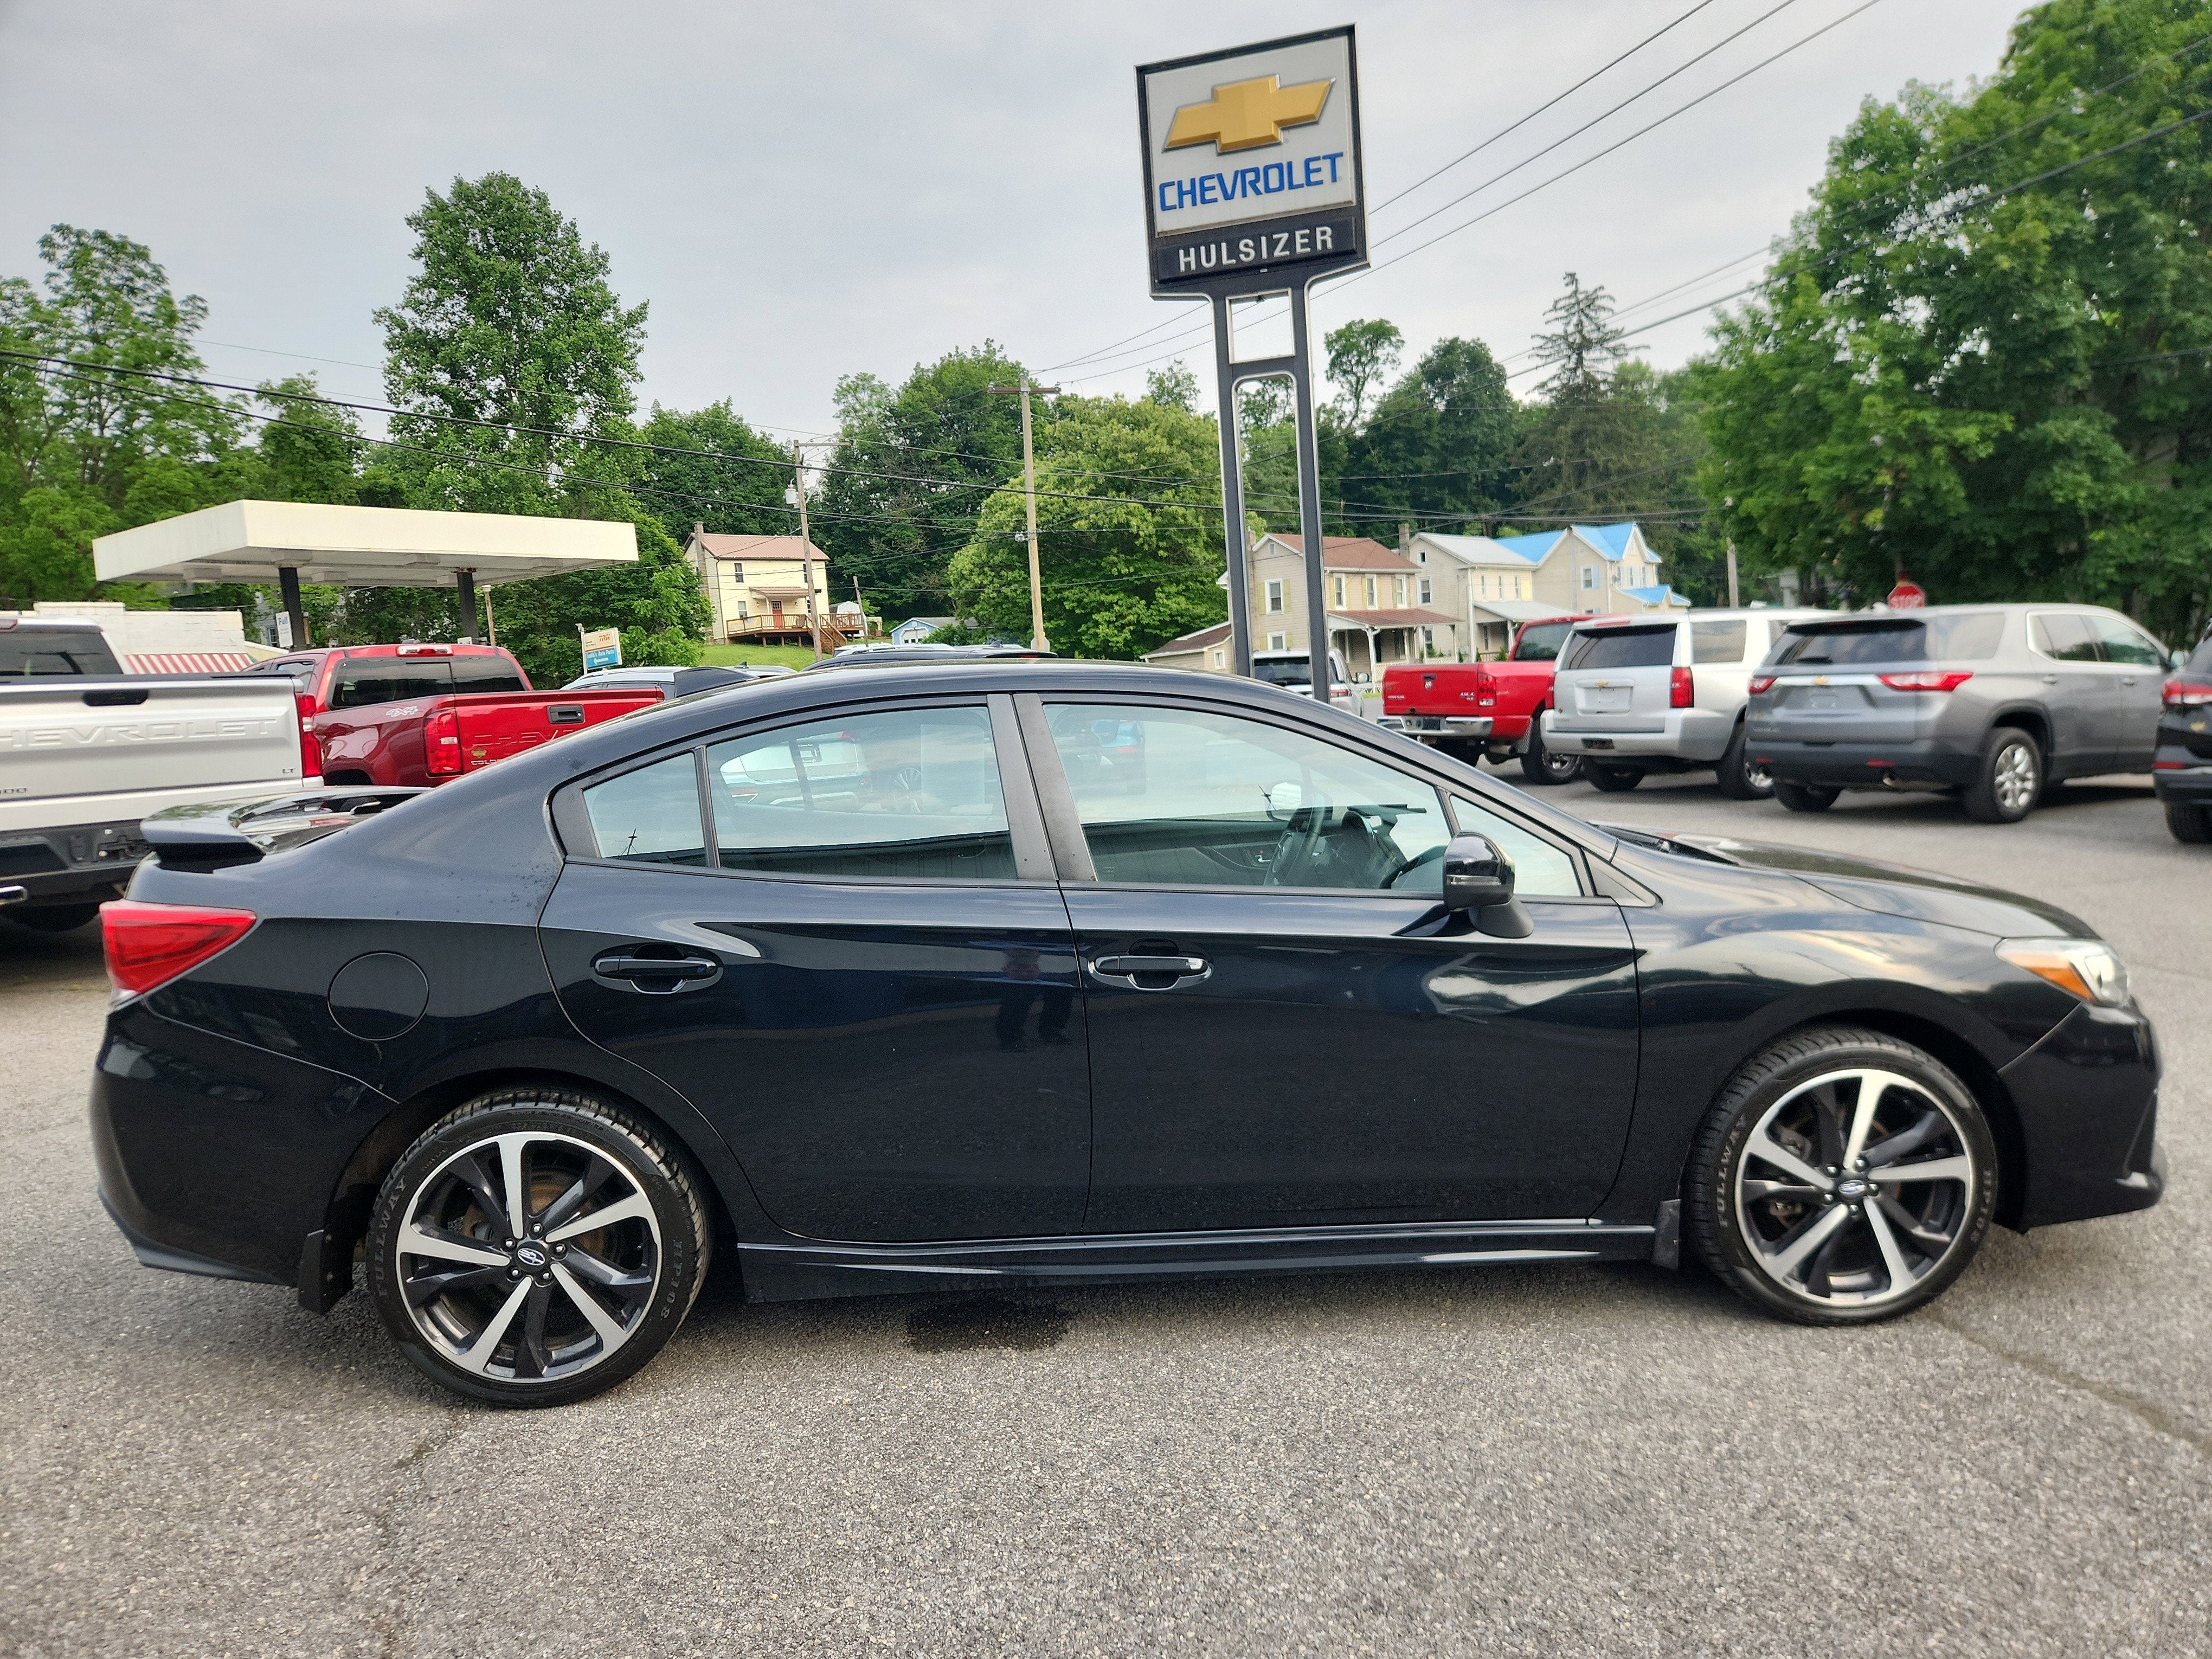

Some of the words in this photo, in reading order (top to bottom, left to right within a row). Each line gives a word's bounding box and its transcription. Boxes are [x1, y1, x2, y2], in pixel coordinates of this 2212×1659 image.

[1159, 152, 1344, 211] CHEVROLET
[1179, 226, 1333, 272] HULSIZER
[1889, 594, 1922, 608] STOP
[472, 729, 574, 746] CHEV
[375, 1175, 406, 1296] FULLWAY
